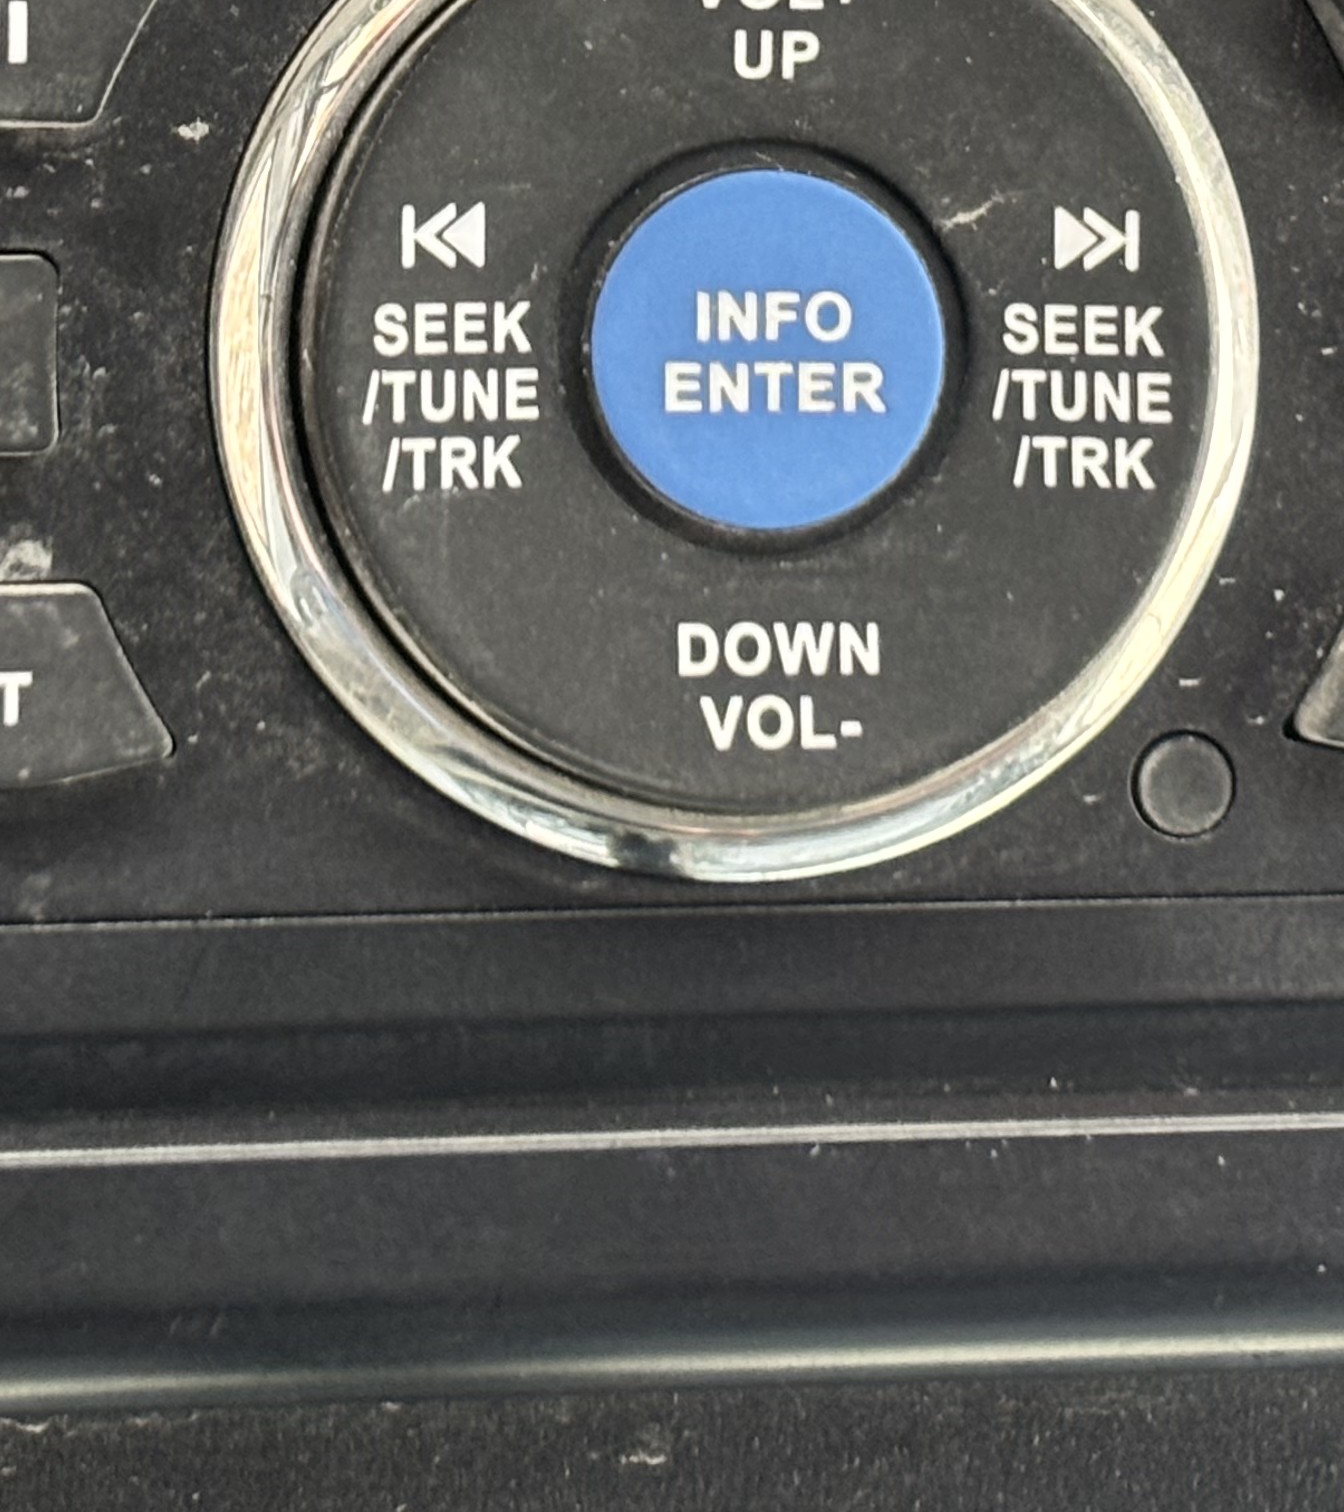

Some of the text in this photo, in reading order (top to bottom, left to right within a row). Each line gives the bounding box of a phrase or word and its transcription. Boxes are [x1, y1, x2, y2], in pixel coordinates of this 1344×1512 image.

[732, 29, 821, 80] UP
[372, 300, 533, 358] SEEK
[695, 290, 853, 344] INFO
[1002, 302, 1166, 358] SEEK
[361, 366, 541, 426] /TUNE
[663, 360, 887, 415] ENTER
[991, 367, 1174, 425] /TUNE
[381, 433, 524, 493] /TRK
[1012, 434, 1156, 490] /TRK
[676, 621, 881, 678] DOWN
[698, 694, 863, 752] VOL-
